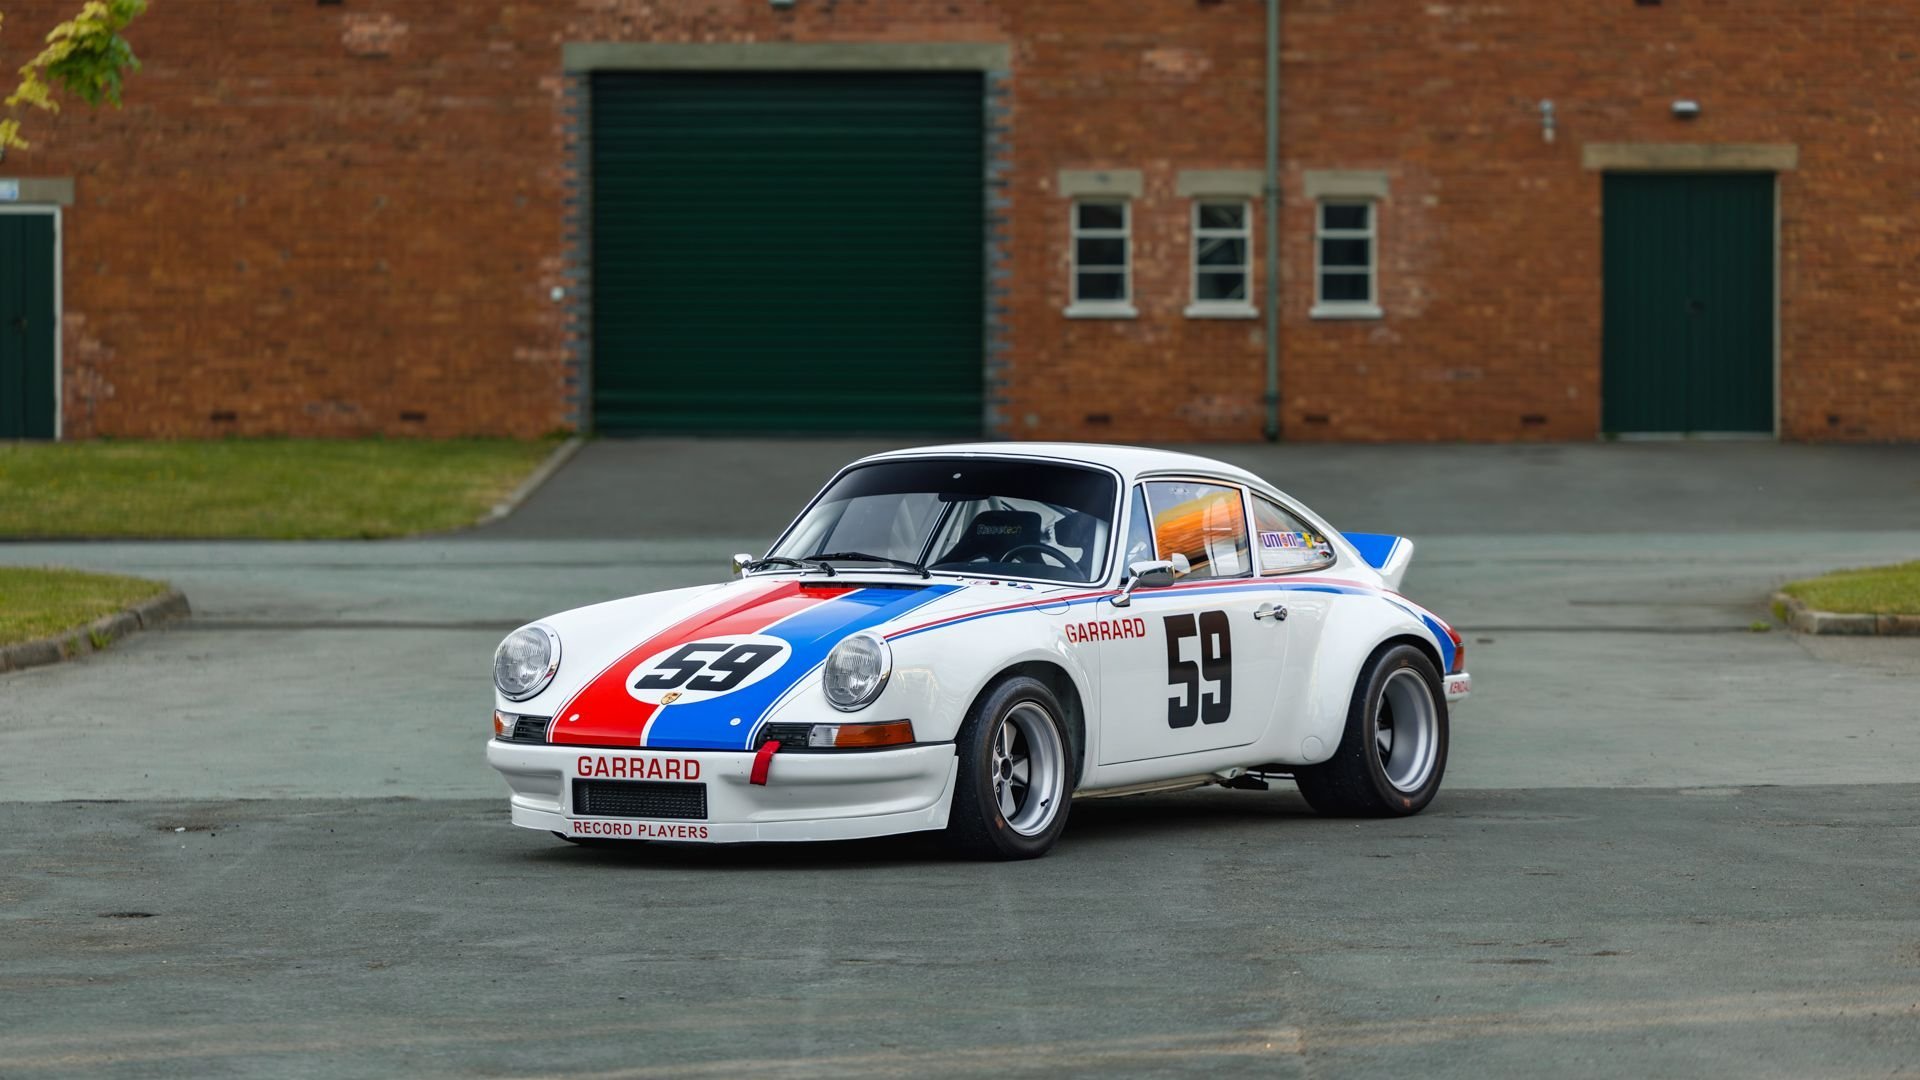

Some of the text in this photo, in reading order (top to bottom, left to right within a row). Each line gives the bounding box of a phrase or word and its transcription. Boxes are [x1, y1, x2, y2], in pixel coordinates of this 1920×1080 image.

[1065, 617, 1146, 643] GARRARD
[634, 643, 783, 691] 59
[1163, 610, 1232, 729] 59
[577, 756, 700, 780] GARRARD
[573, 821, 708, 838] RECORD PLAYERS
